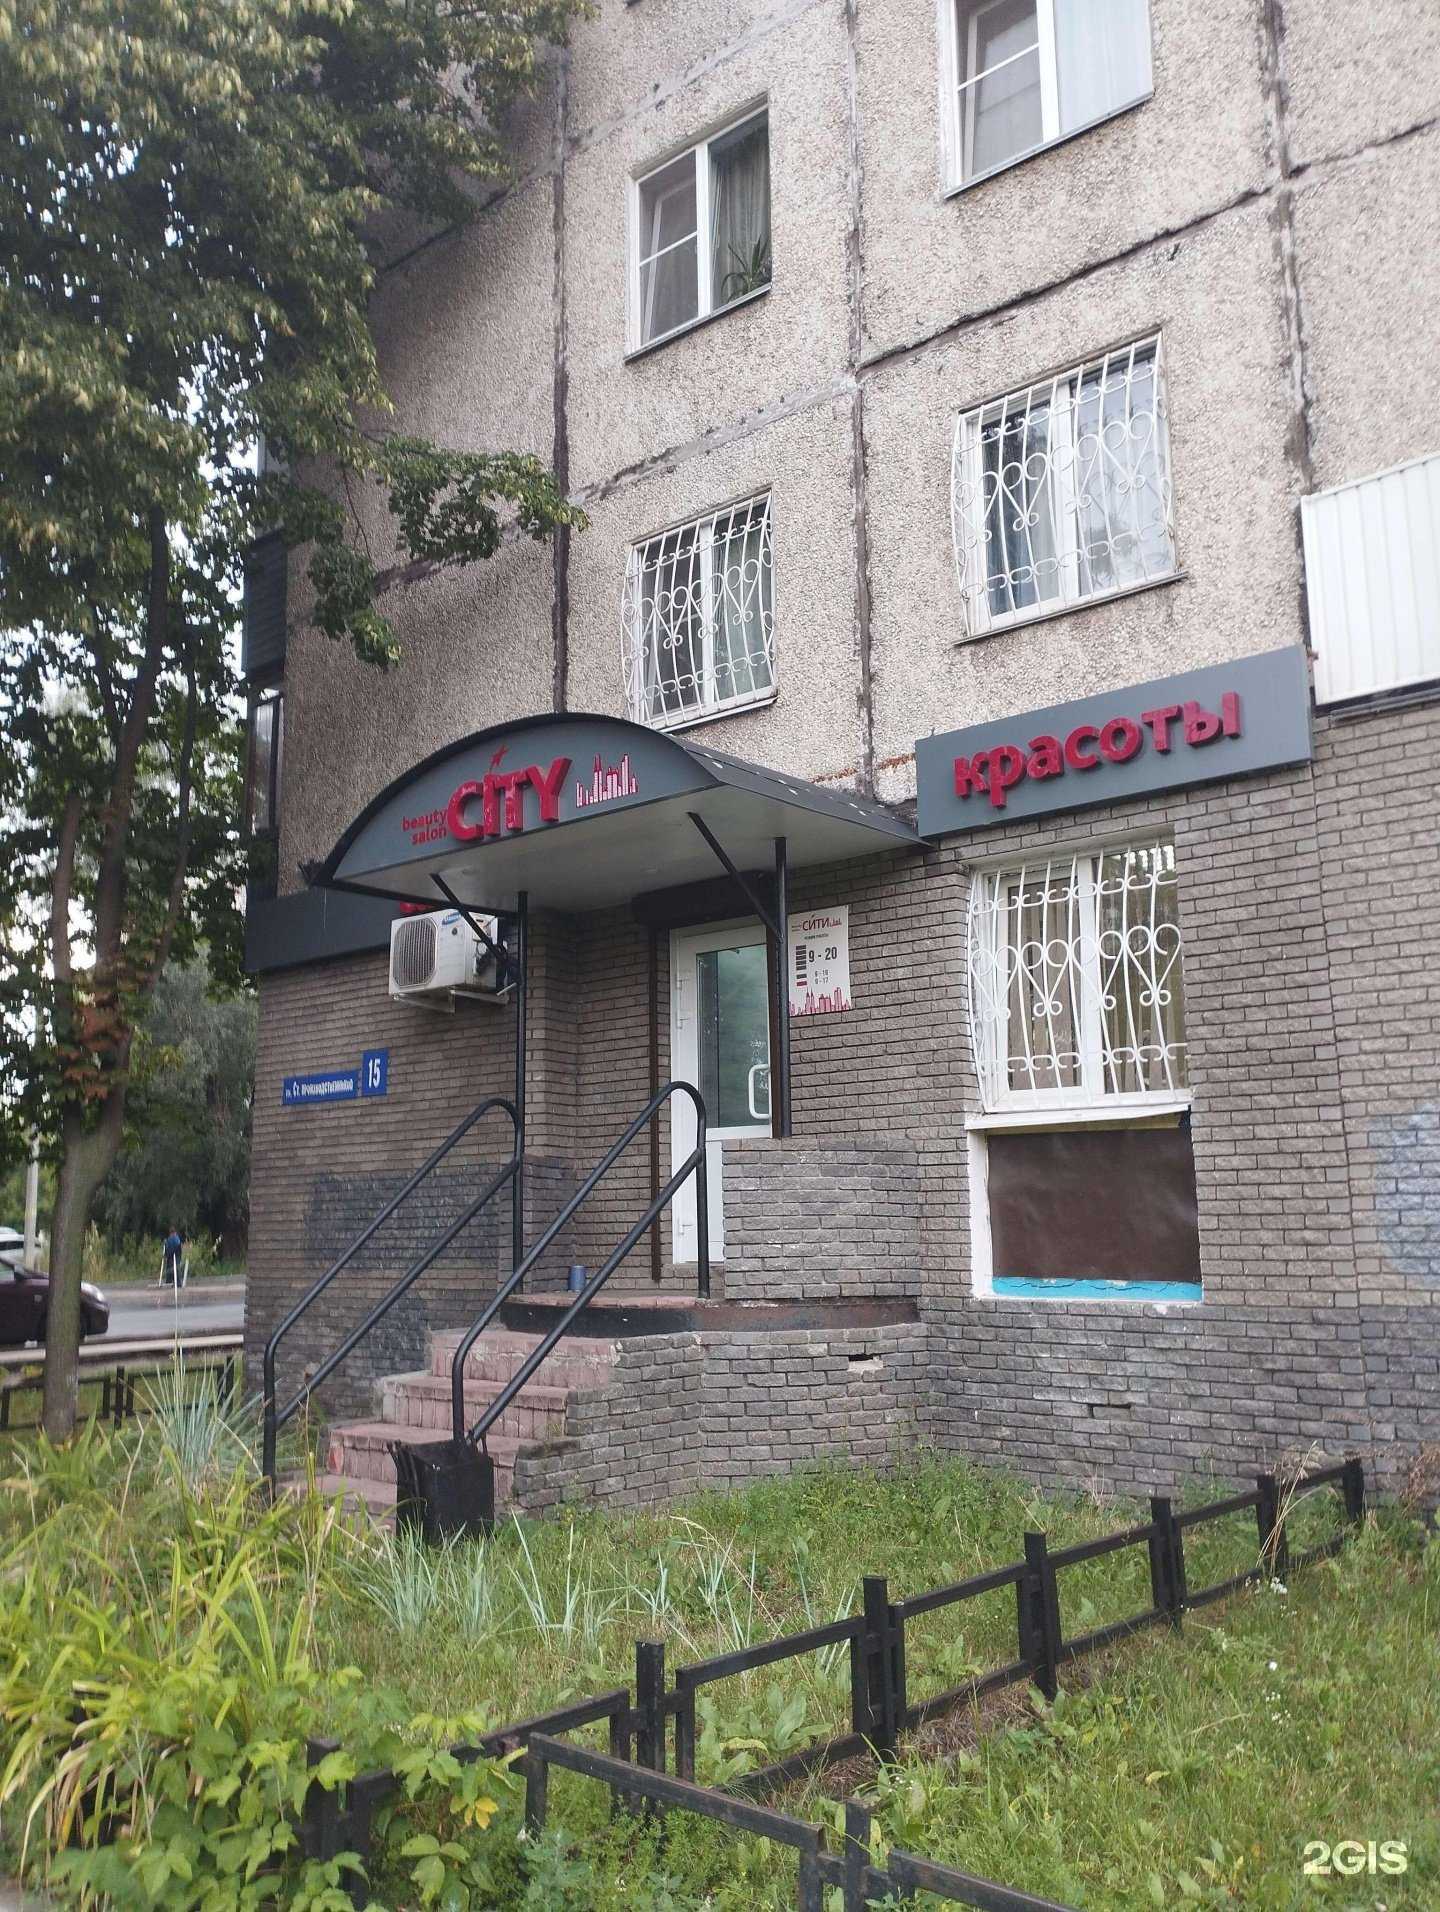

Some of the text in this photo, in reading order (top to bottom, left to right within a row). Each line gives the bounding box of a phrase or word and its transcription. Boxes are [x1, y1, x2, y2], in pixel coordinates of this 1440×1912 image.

[953, 691, 1241, 808] красоты
[448, 757, 572, 841] CITY
[402, 807, 449, 832] beauty
[412, 826, 447, 845] salon
[809, 950, 815, 962] 9
[825, 947, 838, 960] 20
[368, 1058, 381, 1088] 15
